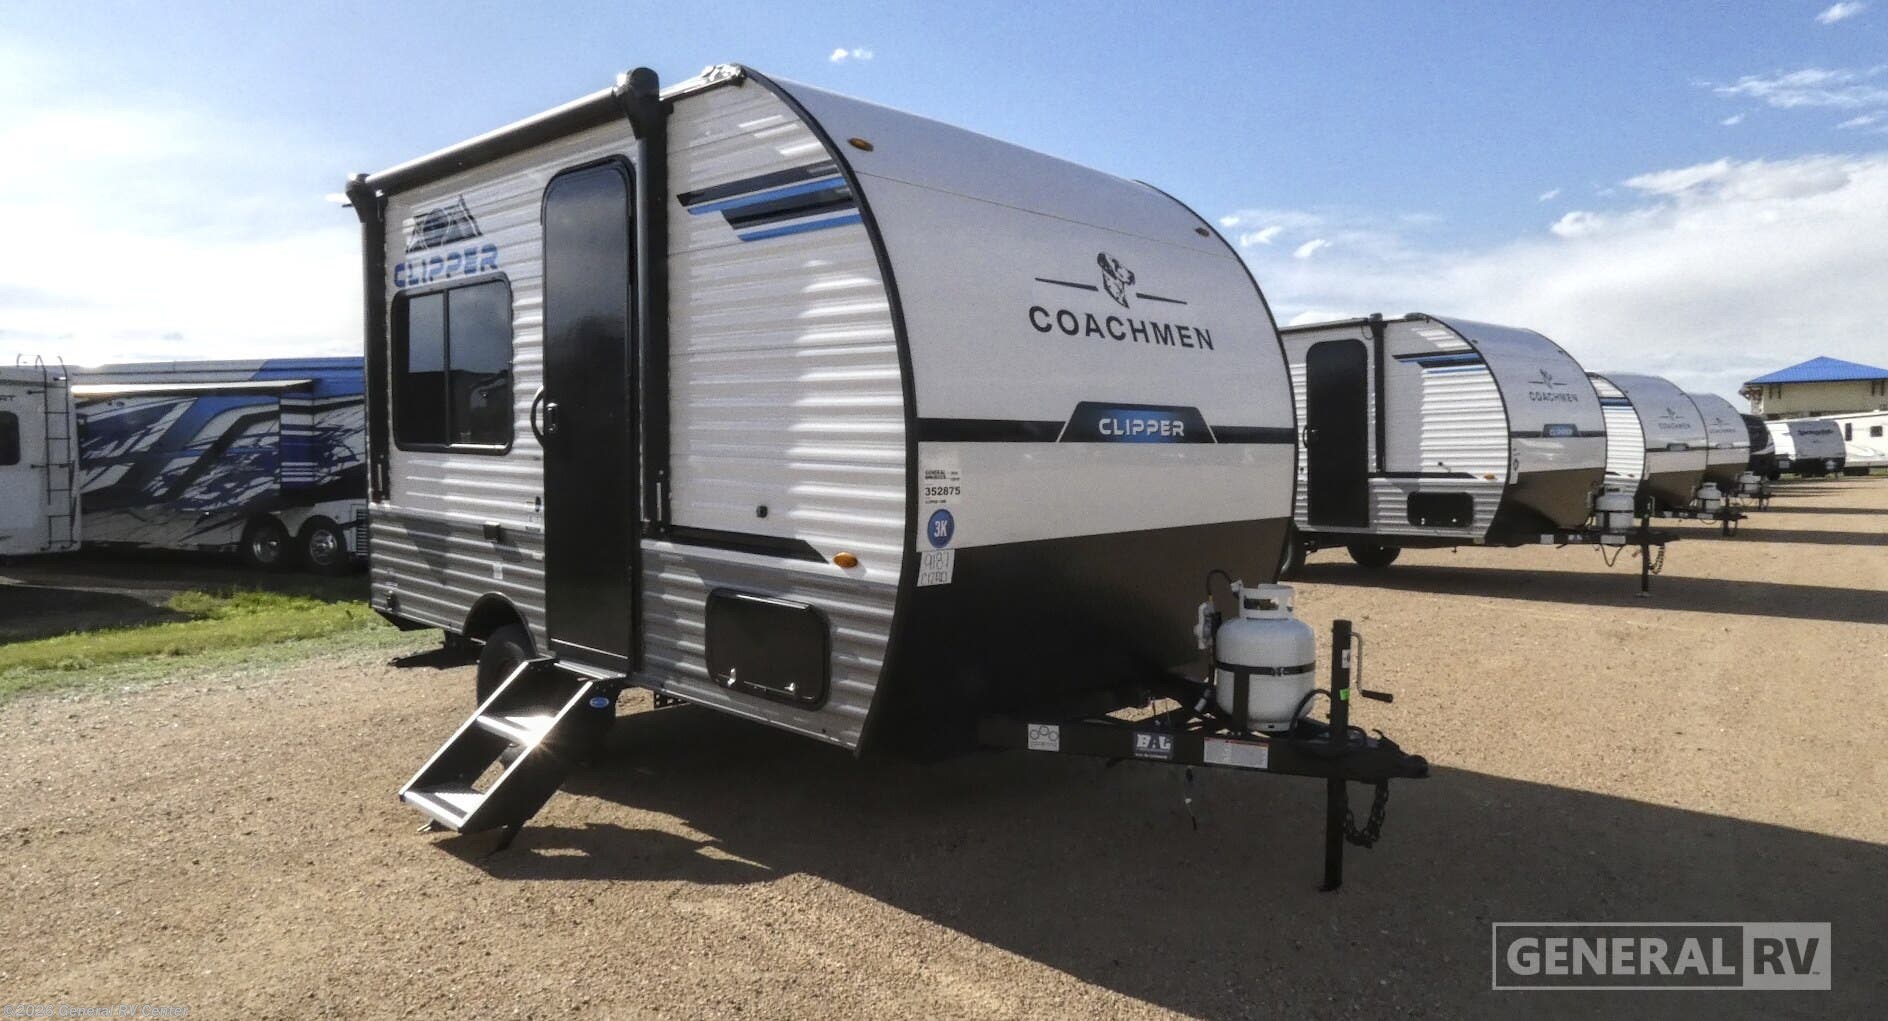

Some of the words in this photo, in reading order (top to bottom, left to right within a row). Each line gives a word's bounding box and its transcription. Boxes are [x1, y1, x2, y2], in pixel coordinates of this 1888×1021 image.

[393, 243, 499, 288] CLIPPER
[1028, 305, 1215, 351] COACHMEN
[1098, 418, 1185, 437] CLIPPER
[924, 486, 961, 496] 352875
[933, 520, 948, 537] 3K
